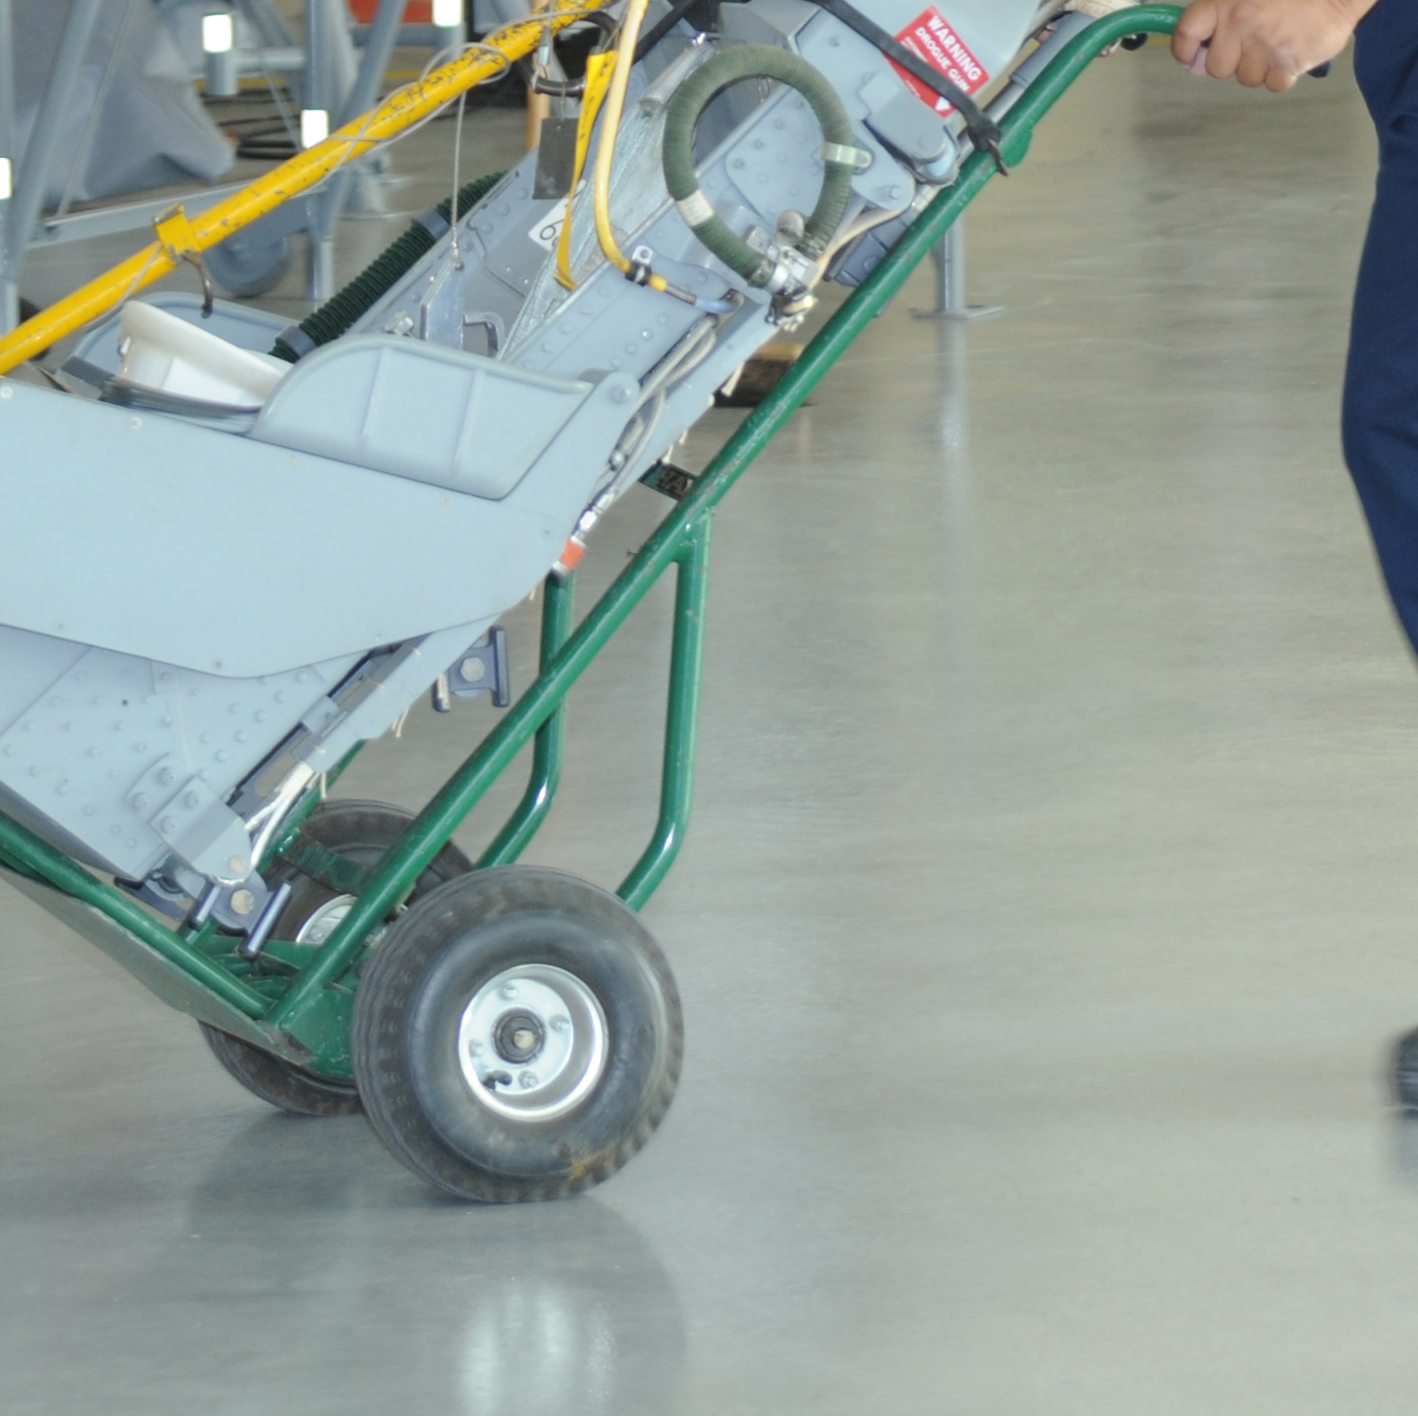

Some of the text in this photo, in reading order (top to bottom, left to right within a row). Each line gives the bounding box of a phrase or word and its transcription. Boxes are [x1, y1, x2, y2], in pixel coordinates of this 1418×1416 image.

[914, 26, 954, 70] DROGUE
[947, 68, 971, 93] GUN
[927, 15, 982, 81] WARNING
